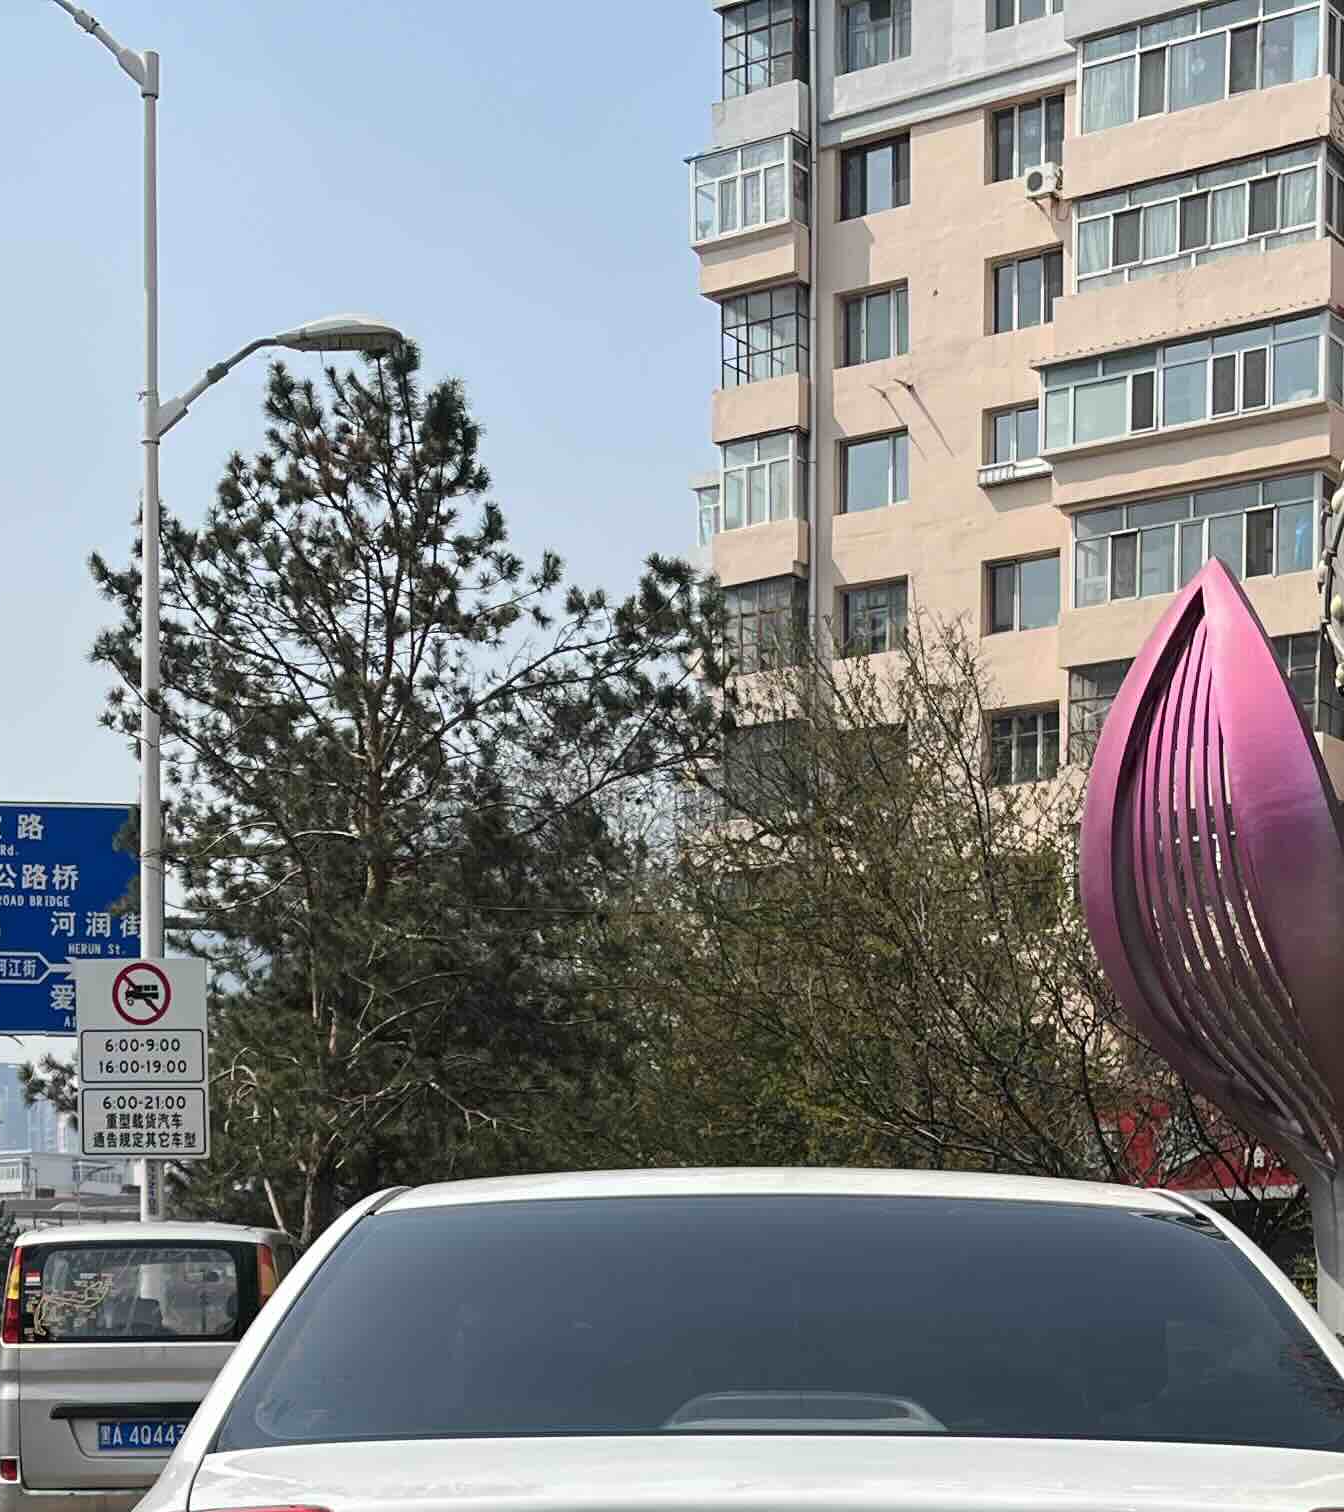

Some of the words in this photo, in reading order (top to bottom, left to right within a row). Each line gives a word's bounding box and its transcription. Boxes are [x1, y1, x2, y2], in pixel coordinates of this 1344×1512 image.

[0, 844, 20, 857] Rd.
[30, 895, 71, 908] BRIDGE
[50, 910, 142, 938] 河润街
[68, 943, 101, 956] HERUN
[102, 1095, 186, 1110] 6:00-21:00
[105, 1112, 184, 1130] 重型载货汽车
[93, 1131, 197, 1149] 通告规定其它车型
